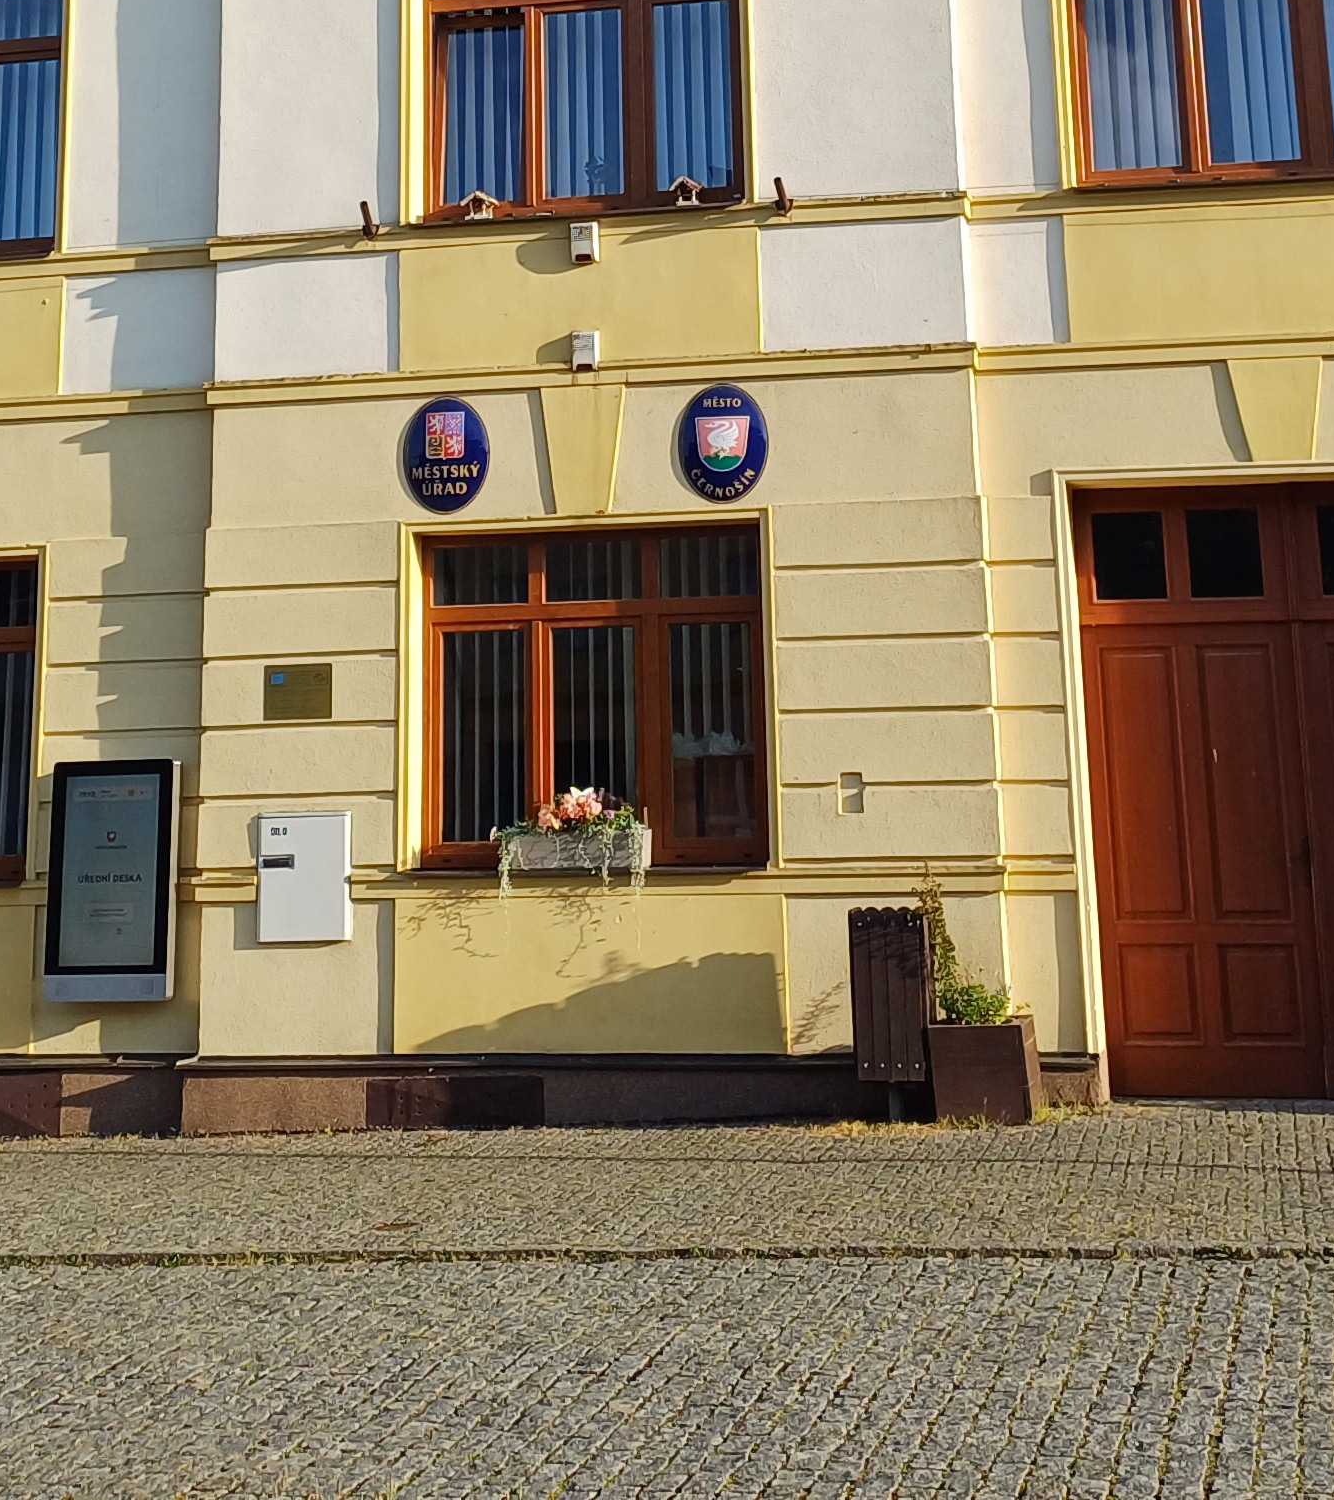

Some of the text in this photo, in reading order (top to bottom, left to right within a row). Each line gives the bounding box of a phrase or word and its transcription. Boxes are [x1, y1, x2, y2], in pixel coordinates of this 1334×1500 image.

[702, 395, 742, 408] MĚSTO
[411, 461, 481, 480] MĚSTSKÝ
[421, 480, 468, 496] ÚŘAD
[690, 467, 756, 498] ČERNOŠÍN
